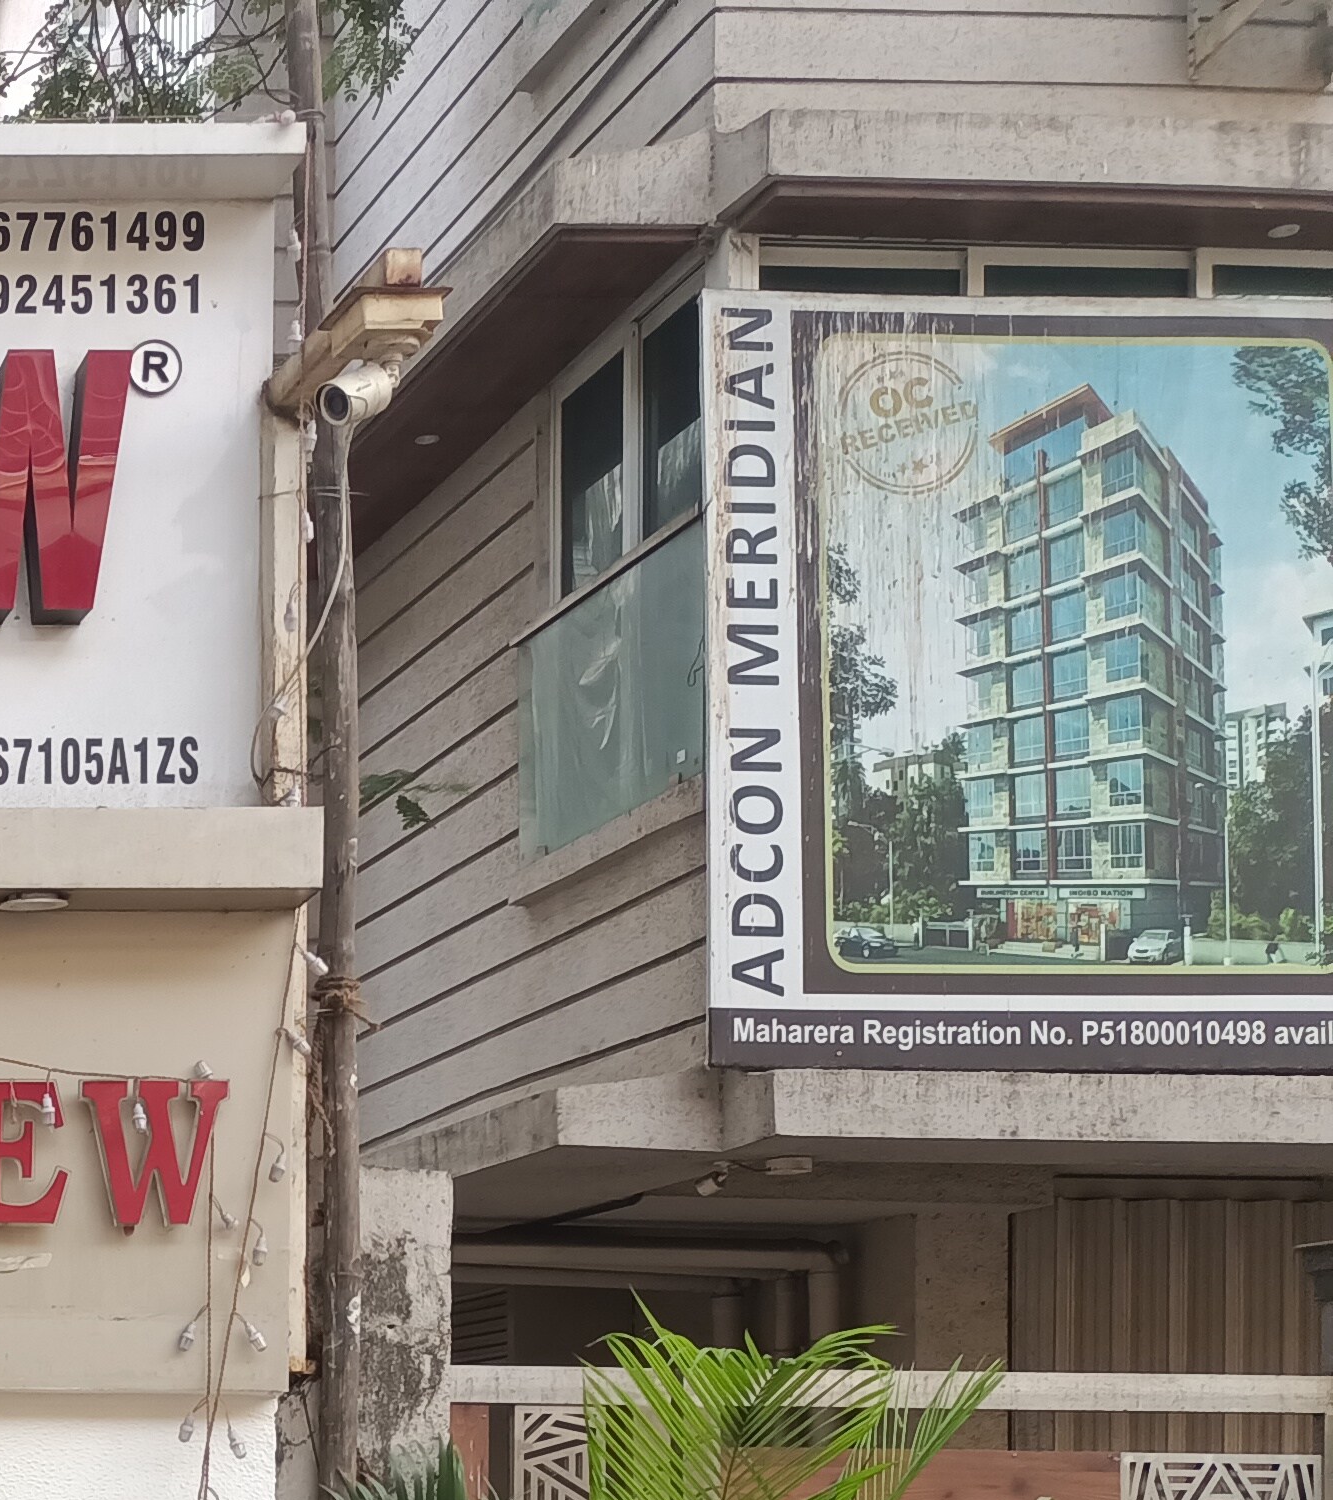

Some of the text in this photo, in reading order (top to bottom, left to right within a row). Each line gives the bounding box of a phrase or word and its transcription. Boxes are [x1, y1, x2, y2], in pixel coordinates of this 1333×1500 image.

[869, 376, 934, 418] OC
[839, 399, 979, 456] RECEIVED
[720, 306, 785, 998] ADCON MERIDIAN
[1100, 889, 1133, 897] NATION
[733, 1017, 855, 1045] Maharera
[863, 1018, 1022, 1051] Registration
[1030, 1020, 1074, 1046] No.
[1082, 1020, 1266, 1046] P51800010498
